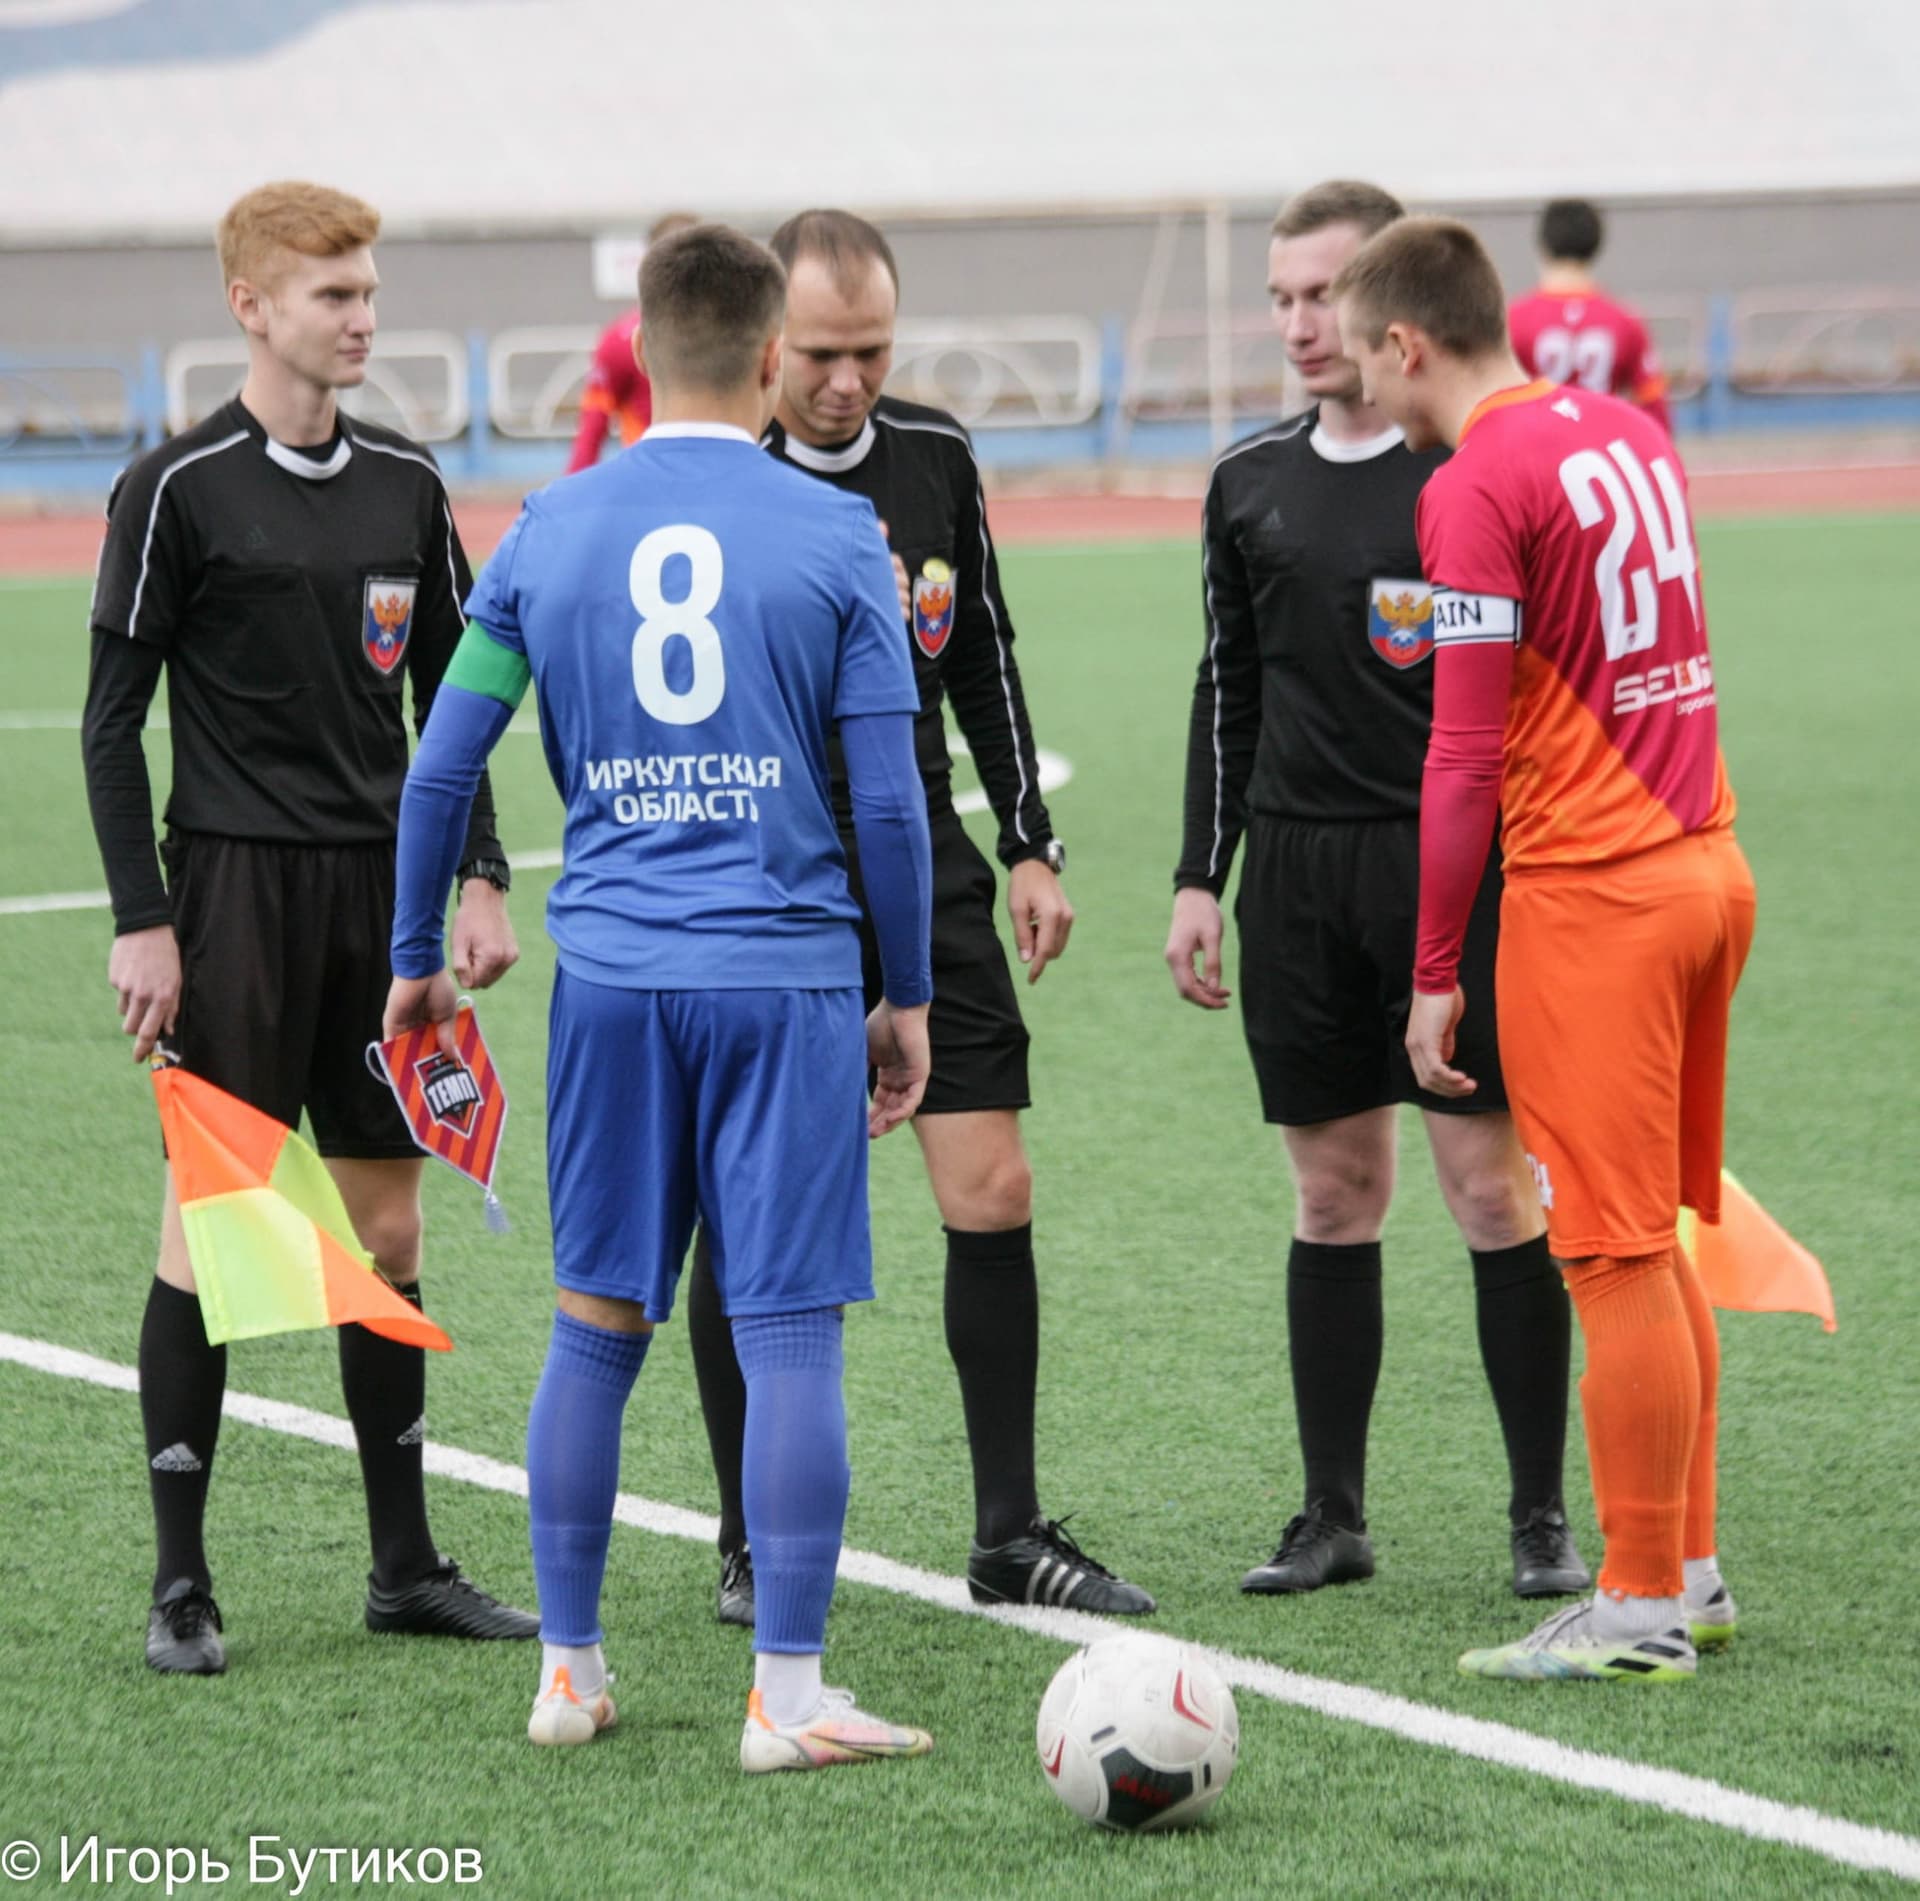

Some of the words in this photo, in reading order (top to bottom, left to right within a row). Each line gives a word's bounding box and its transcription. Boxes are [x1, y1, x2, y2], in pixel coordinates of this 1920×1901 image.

[1559, 438, 1699, 662] 24
[629, 524, 725, 725] 8
[1436, 599, 1482, 630] AIN
[586, 753, 782, 791] ИРКУТСКАЯ
[427, 1072, 477, 1114] ТЕМП
[152, 1458, 202, 1472] adidas
